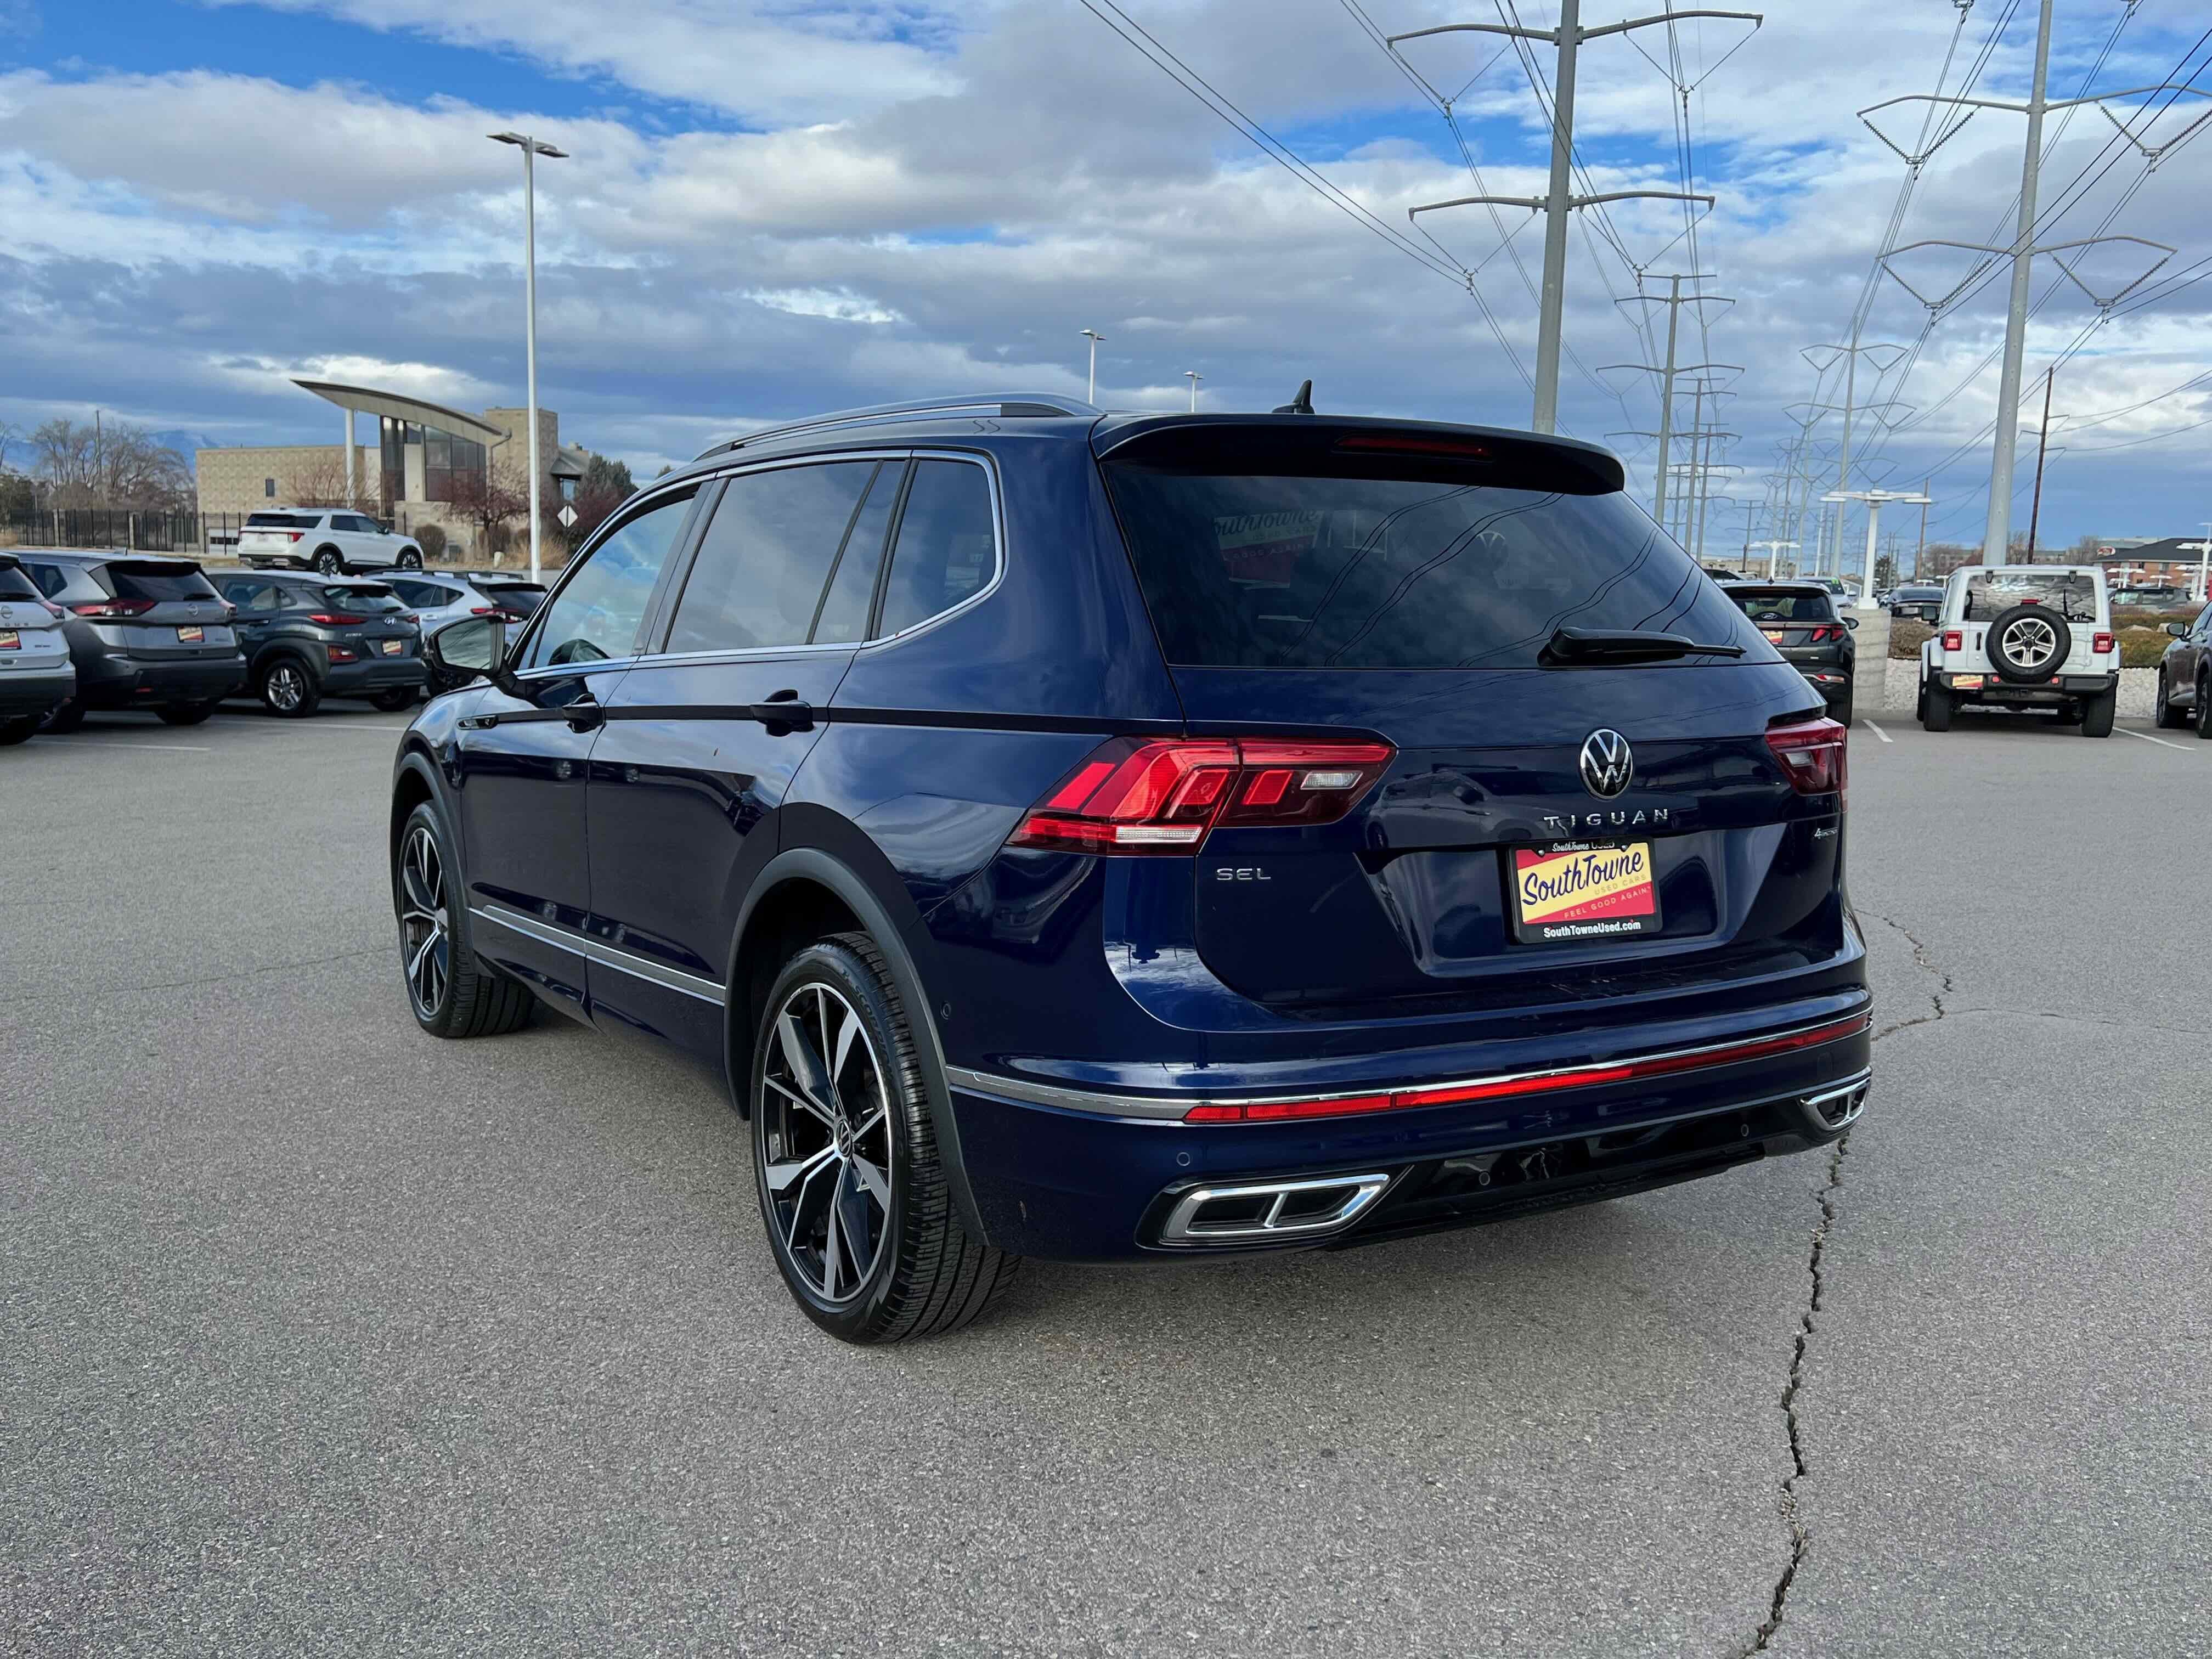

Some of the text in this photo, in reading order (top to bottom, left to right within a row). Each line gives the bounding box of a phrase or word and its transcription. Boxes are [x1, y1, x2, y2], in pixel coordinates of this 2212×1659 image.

[1544, 809, 1668, 830] TIGUAN
[1217, 868, 1271, 881] SEL
[1522, 851, 1644, 905] SouthTowne
[1594, 874, 1646, 895] USED CARS
[1564, 908, 1587, 919] FEEL
[1591, 898, 1616, 911] GOOD
[1544, 921, 1641, 938] SouthTowneUsed.com
